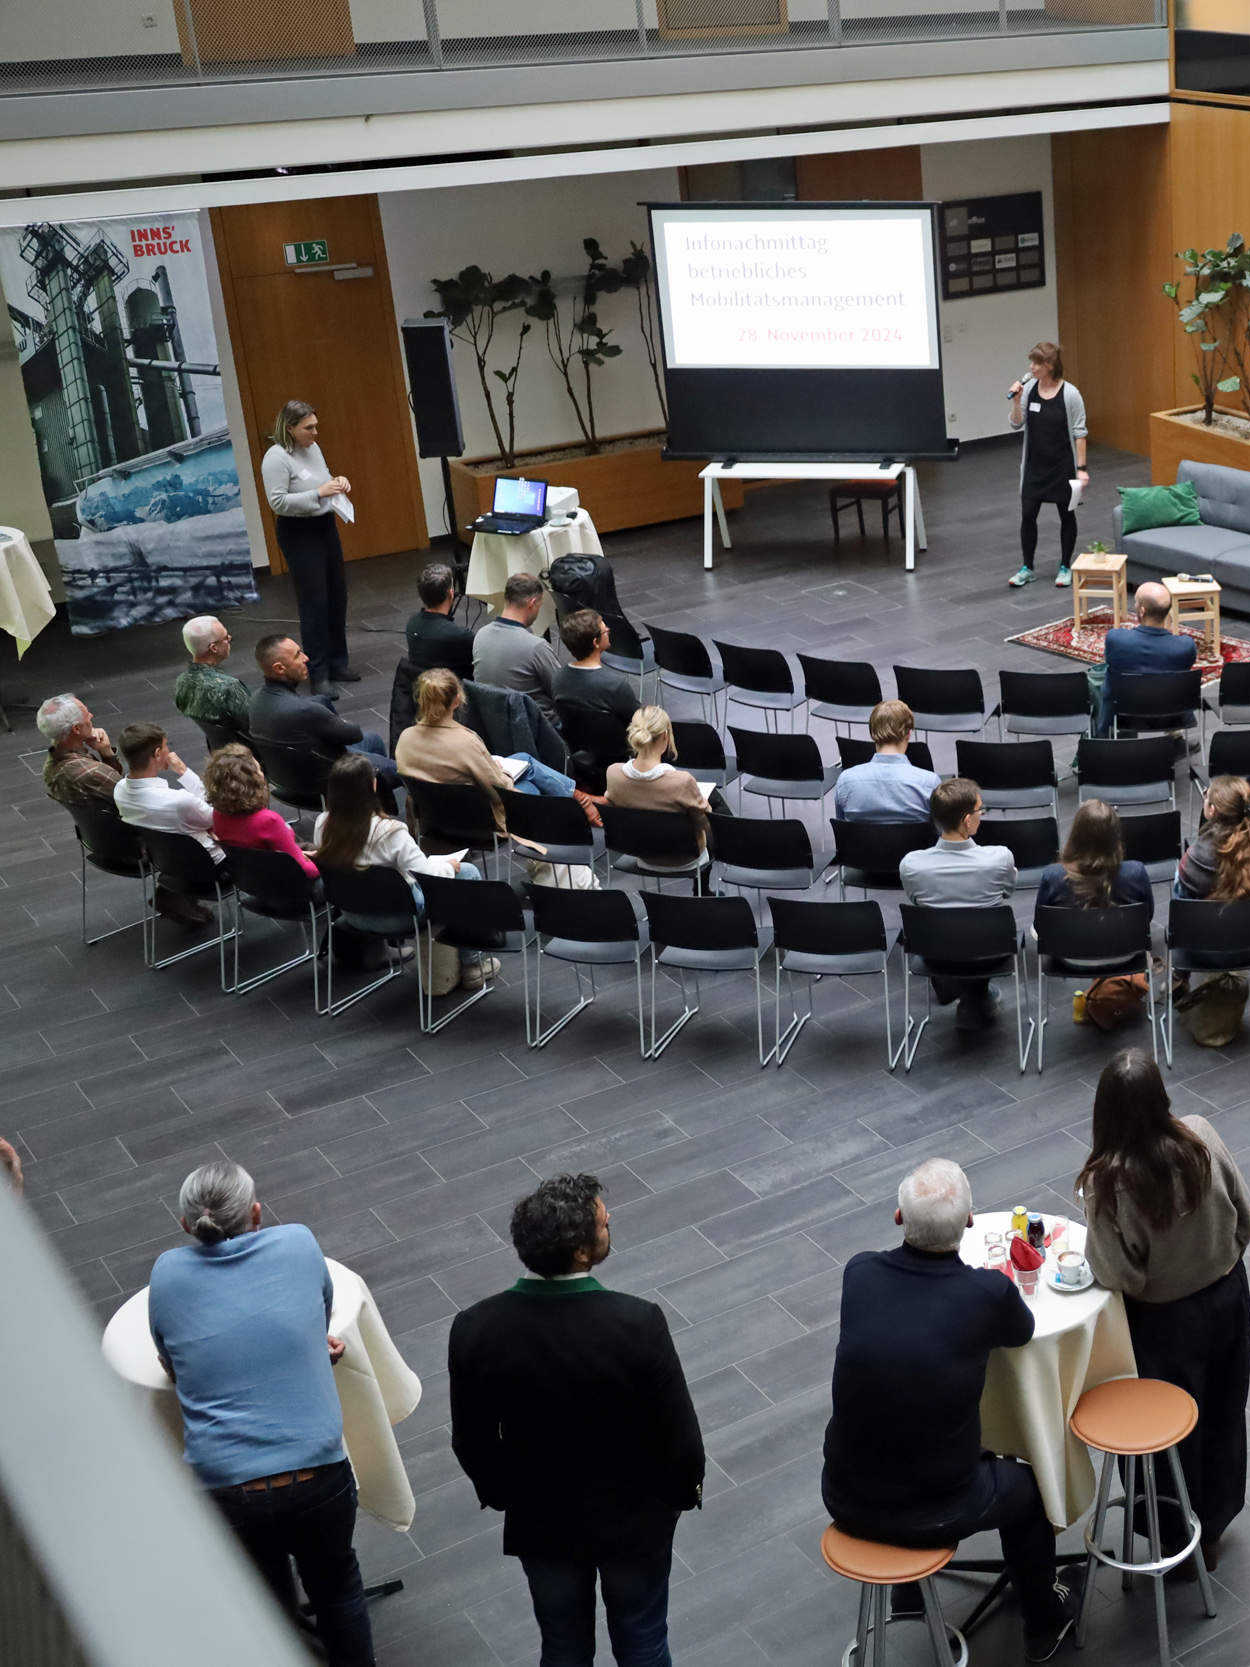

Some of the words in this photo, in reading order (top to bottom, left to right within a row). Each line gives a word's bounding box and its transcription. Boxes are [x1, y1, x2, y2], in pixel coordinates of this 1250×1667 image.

[130, 225, 175, 243] INNS'
[132, 239, 192, 258] BRUCK
[685, 233, 828, 255] Infonachmittag
[687, 262, 807, 279] betriebliches
[690, 291, 906, 312] Mobilitätsmanagement
[767, 327, 855, 342] November
[861, 328, 903, 342] 2024
